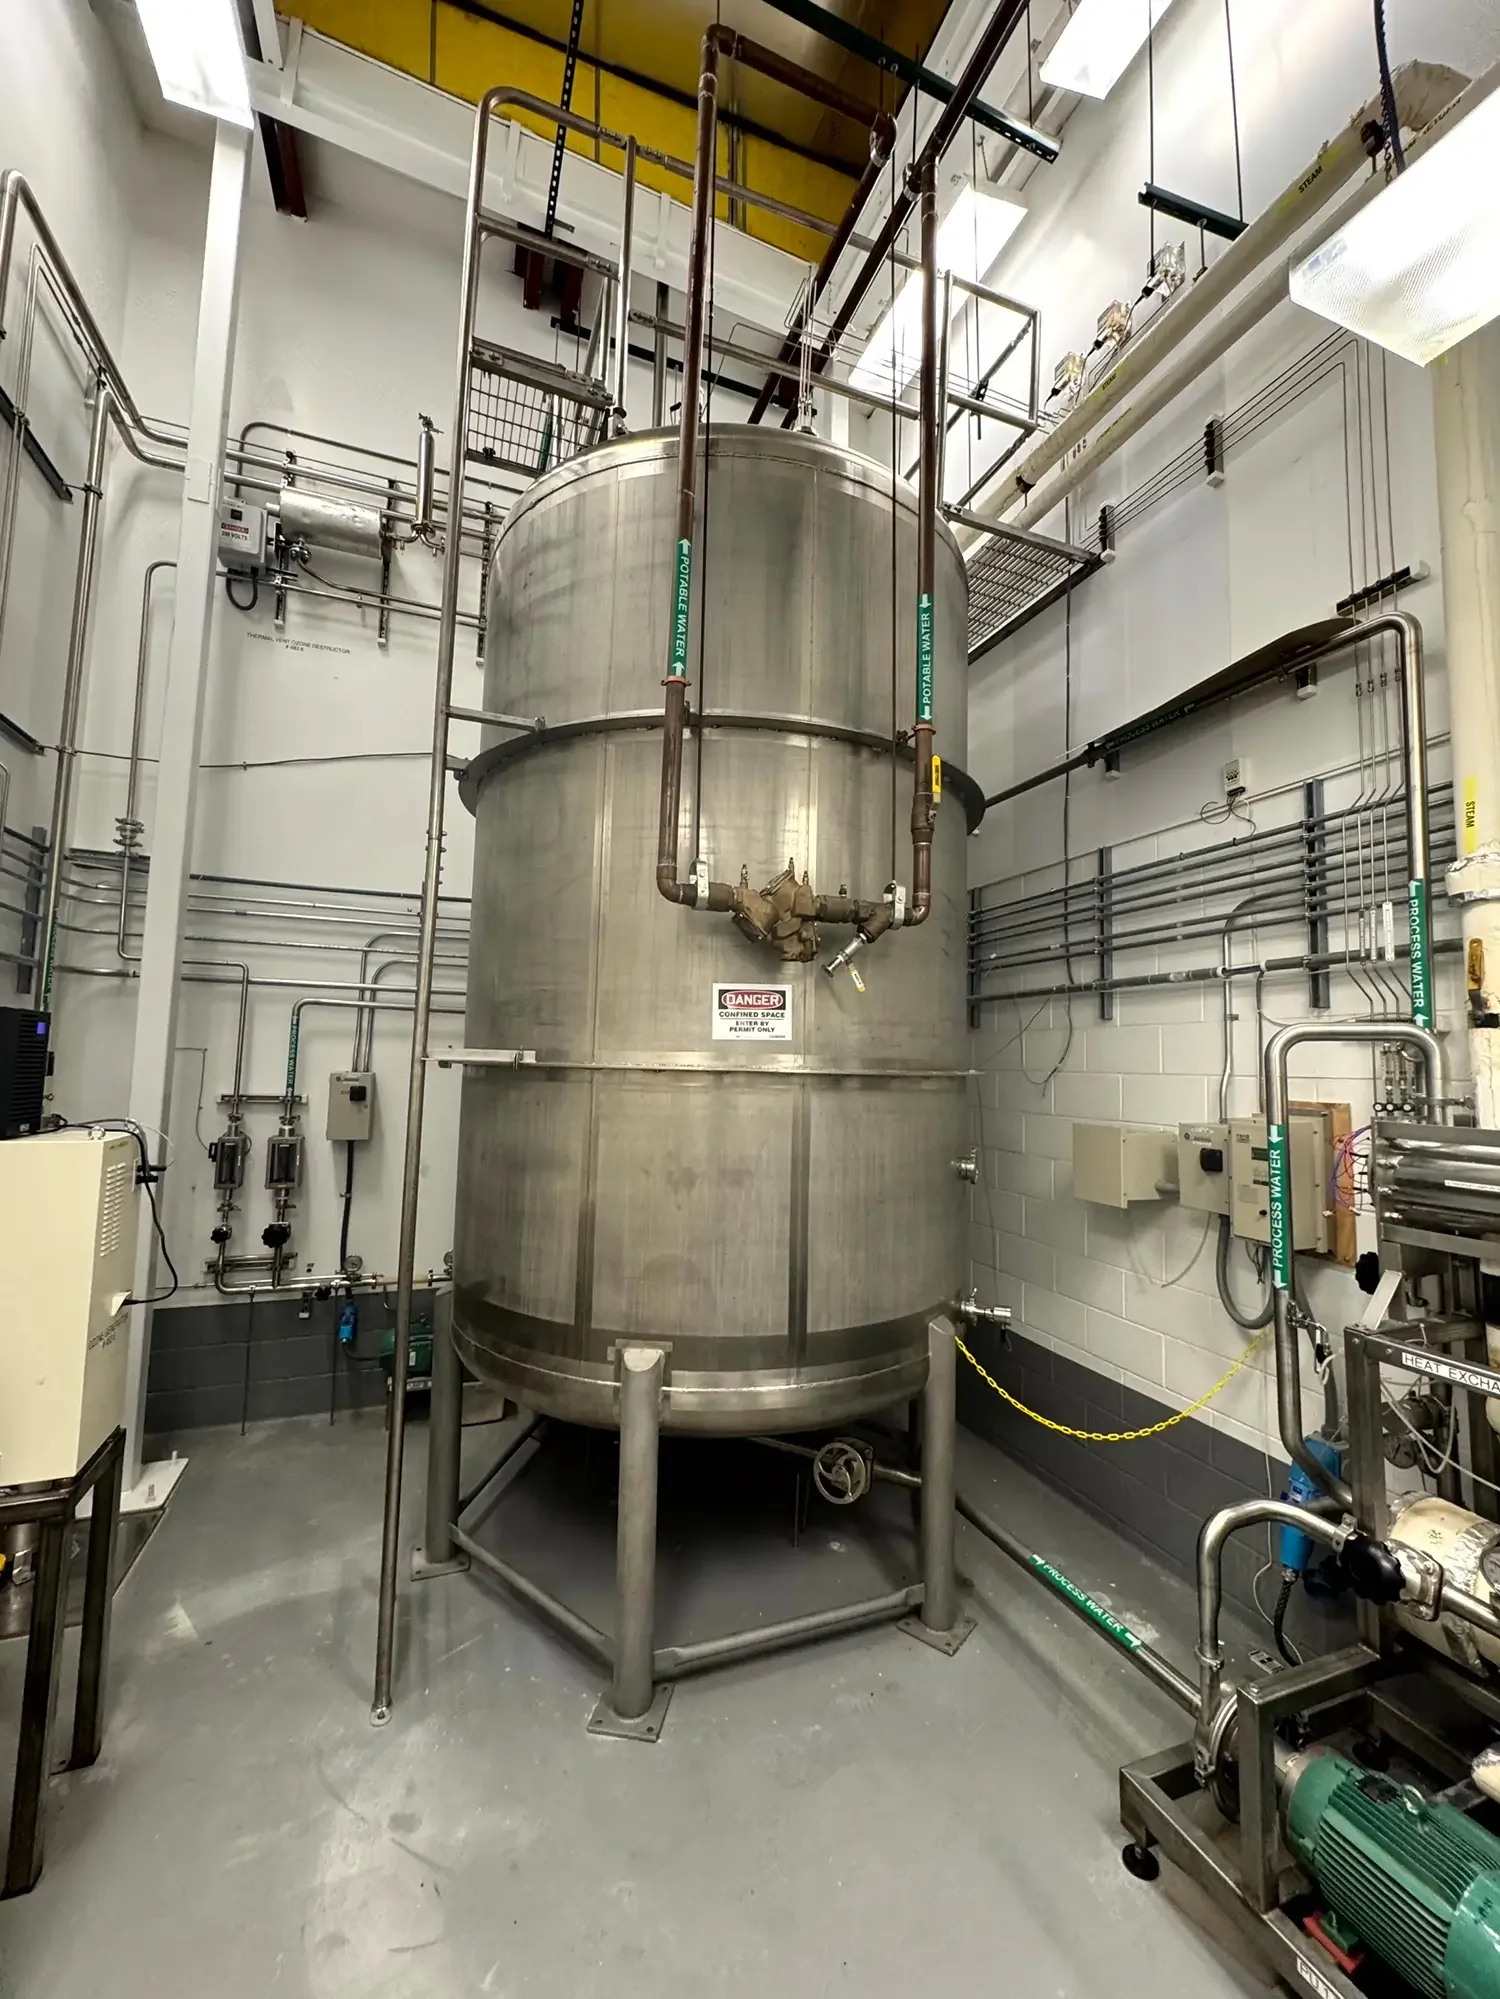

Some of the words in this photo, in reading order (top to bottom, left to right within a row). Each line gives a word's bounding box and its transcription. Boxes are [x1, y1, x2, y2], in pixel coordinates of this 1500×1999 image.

[1298, 165, 1324, 194] STEAM
[231, 532, 248, 542] VOLTS
[678, 555, 690, 612] POTABLE
[246, 631, 274, 642] THERMAL
[275, 637, 291, 645] VENT
[291, 639, 311, 648] OZONE
[312, 643, 351, 655] DESTRUCTOR
[675, 614, 687, 658] WATER
[921, 613, 931, 652] WATER
[922, 653, 932, 705] POTABLE
[1465, 800, 1476, 829] STEAM
[1409, 899, 1421, 960] PROCESS
[726, 994, 779, 1006] DANGER
[1411, 961, 1425, 1008] WATER
[289, 1025, 298, 1058] PROCESS
[287, 1059, 296, 1085] WATER
[1269, 1149, 1282, 1198] WATER
[1271, 1201, 1284, 1268] PROCESS
[1404, 1354, 1441, 1374] HEAT
[1448, 1367, 1500, 1392] EXCHA
[1043, 1563, 1087, 1601] PROCESS
[1086, 1599, 1124, 1633] WATER
